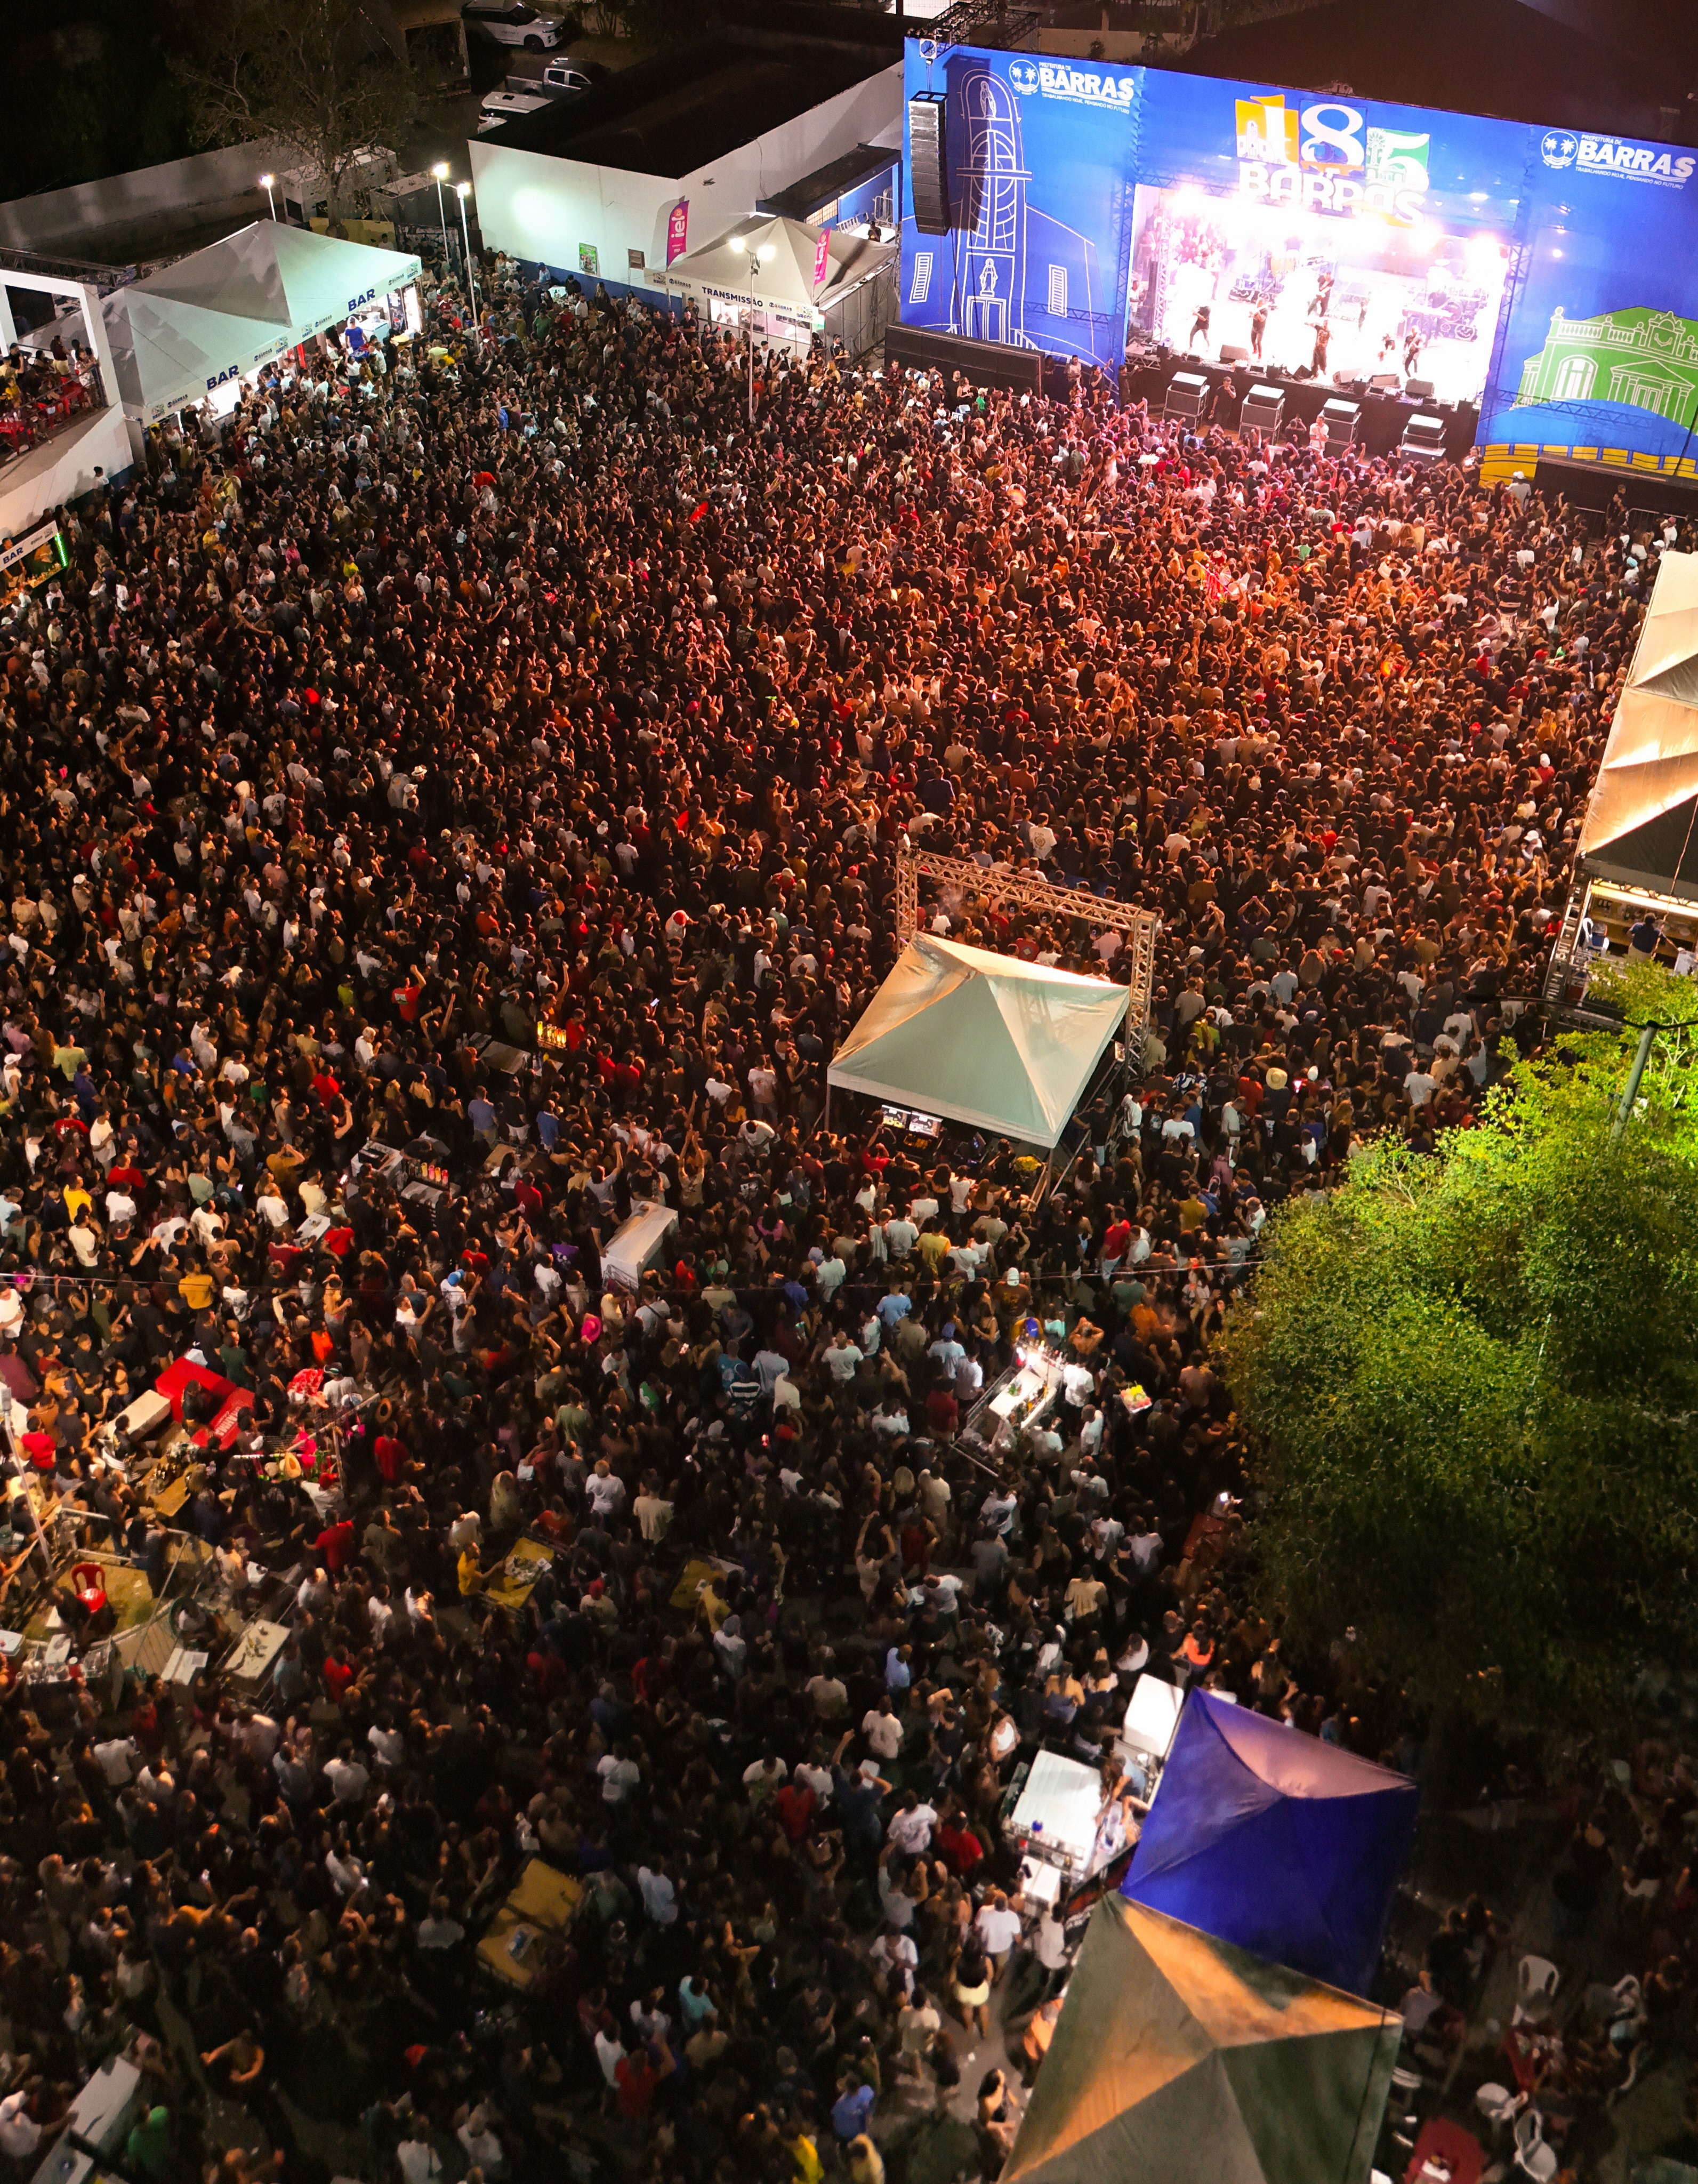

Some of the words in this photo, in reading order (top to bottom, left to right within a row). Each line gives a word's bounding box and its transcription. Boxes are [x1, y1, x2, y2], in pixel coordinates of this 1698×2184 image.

[1039, 62, 1065, 70] PREFEITURA
[1039, 67, 1134, 101] BARRAS
[1042, 93, 1072, 102] TRABALHANDO
[1084, 100, 1106, 108] PENSANDO
[1113, 105, 1130, 114] FUTURO
[1250, 94, 1430, 192] 185
[1581, 134, 1614, 144] PREFEITURA
[1577, 140, 1696, 178] BARRAS
[1575, 166, 1611, 176] TRABALHANDO
[1625, 175, 1653, 184] PENSANDO
[1662, 181, 1684, 190] FUTURO
[1239, 161, 1427, 224] BARRAS
[671, 215, 685, 238] iel
[348, 288, 376, 312] BAR
[702, 286, 763, 307] TRANSMISSÃO
[206, 365, 239, 390] BAR
[3, 547, 23, 564] BAR
